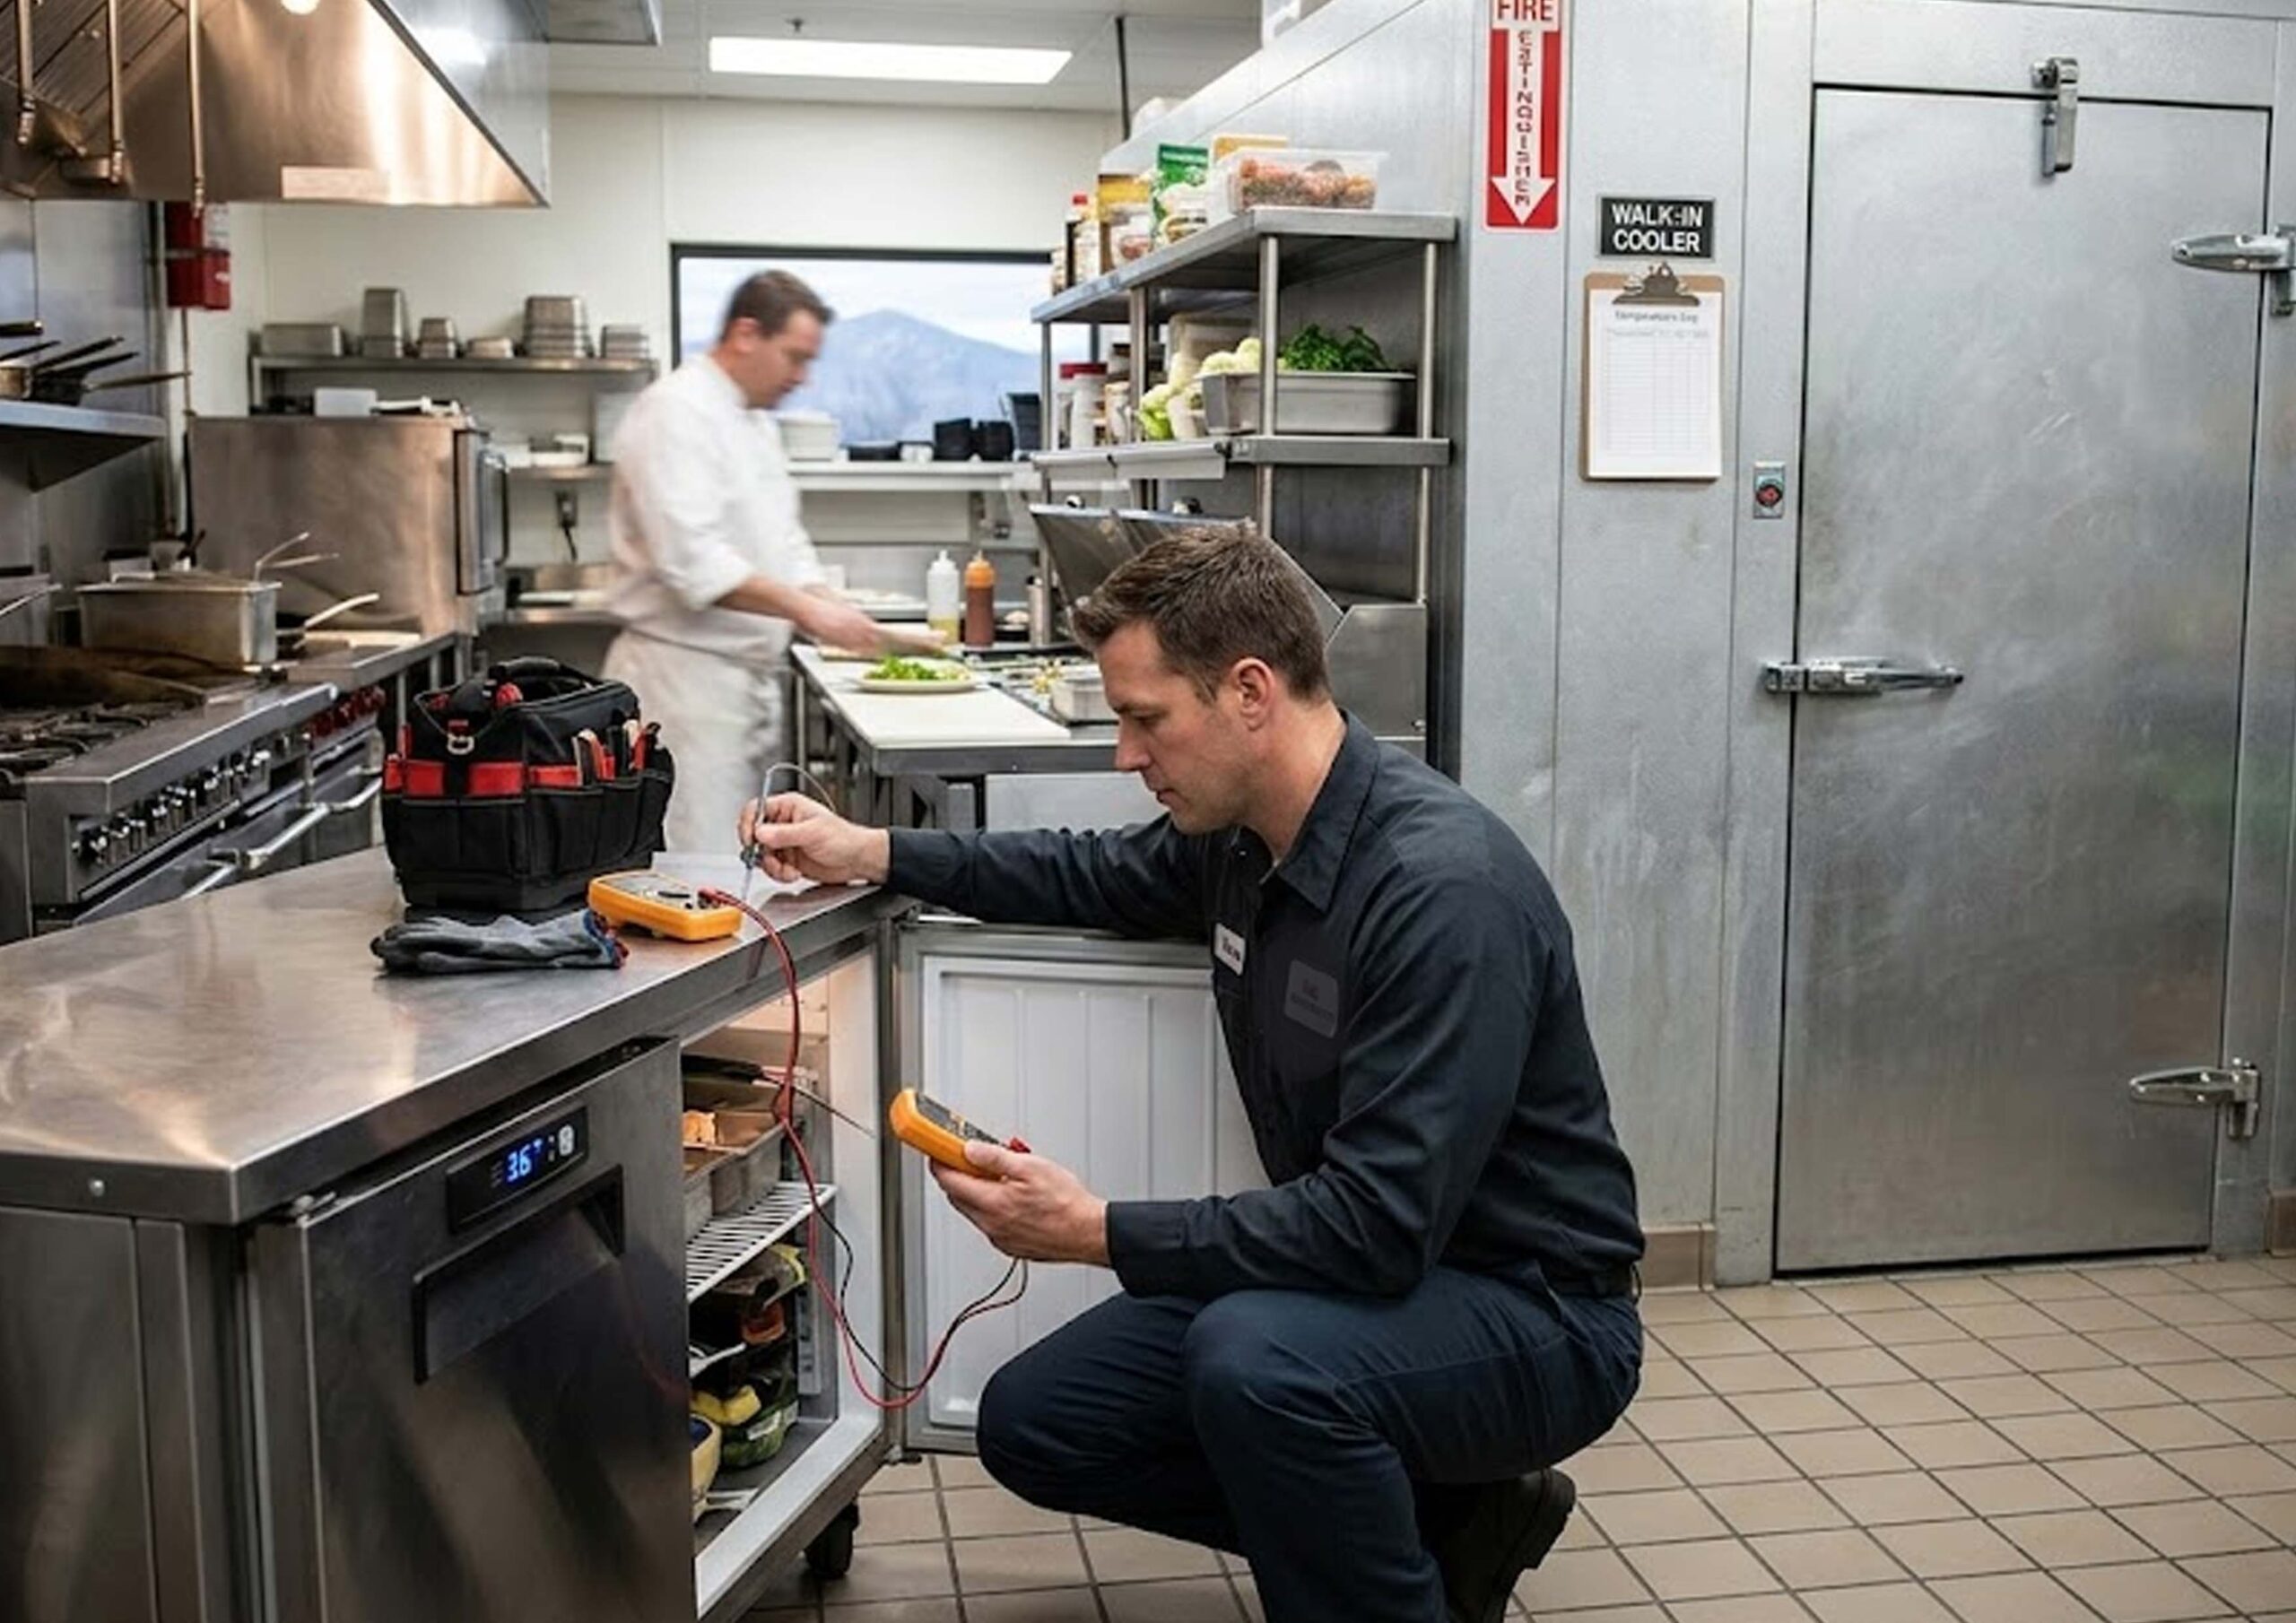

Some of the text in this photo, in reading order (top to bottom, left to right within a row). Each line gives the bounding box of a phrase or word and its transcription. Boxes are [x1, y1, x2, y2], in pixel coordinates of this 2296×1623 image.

[1497, 0, 1553, 20] FIRE
[1612, 204, 1703, 227] WALK-IN
[1613, 229, 1700, 252] COOLER
